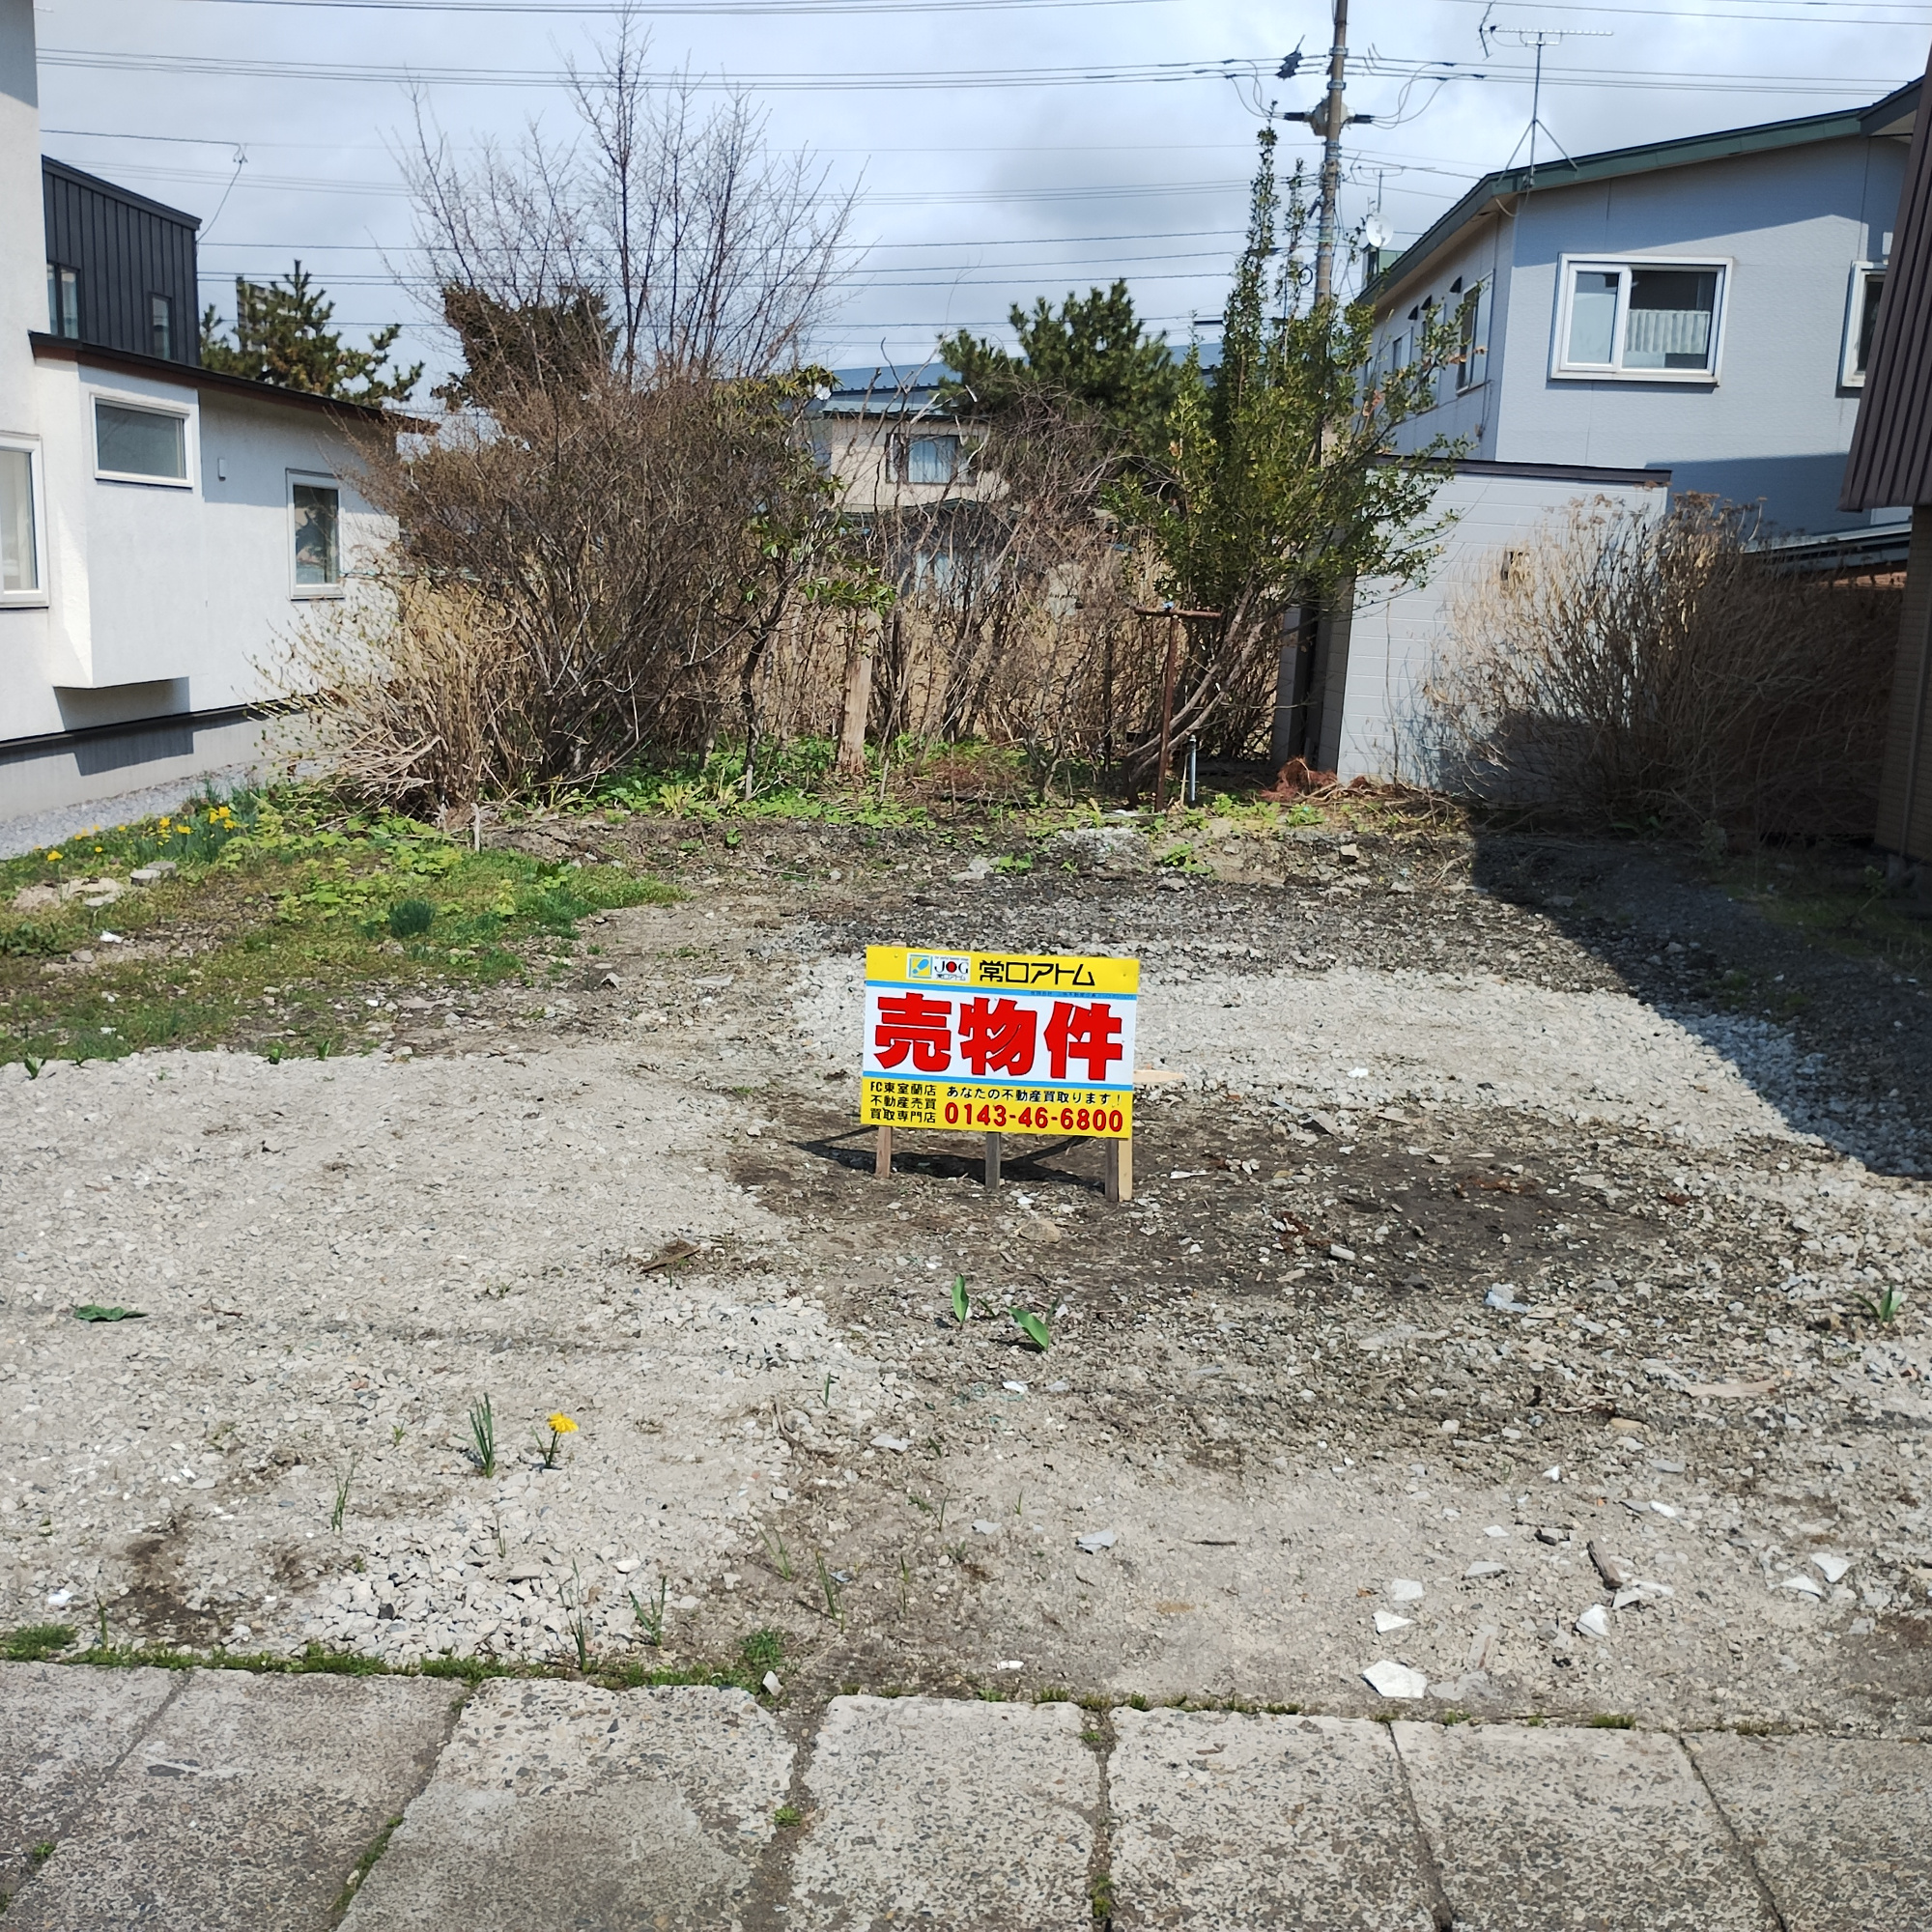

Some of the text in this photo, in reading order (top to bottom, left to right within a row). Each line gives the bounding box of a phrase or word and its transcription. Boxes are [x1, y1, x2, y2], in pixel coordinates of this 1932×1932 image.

[934, 960, 968, 974] JOG
[980, 959, 1095, 986] 常口アトム
[874, 992, 1123, 1081] 売物件
[870, 1081, 937, 1096] FC東室蘭店
[870, 1094, 937, 1110] 不動産売買
[870, 1108, 937, 1123] 買取専門店
[945, 1102, 1123, 1132] 0143-46-6800
